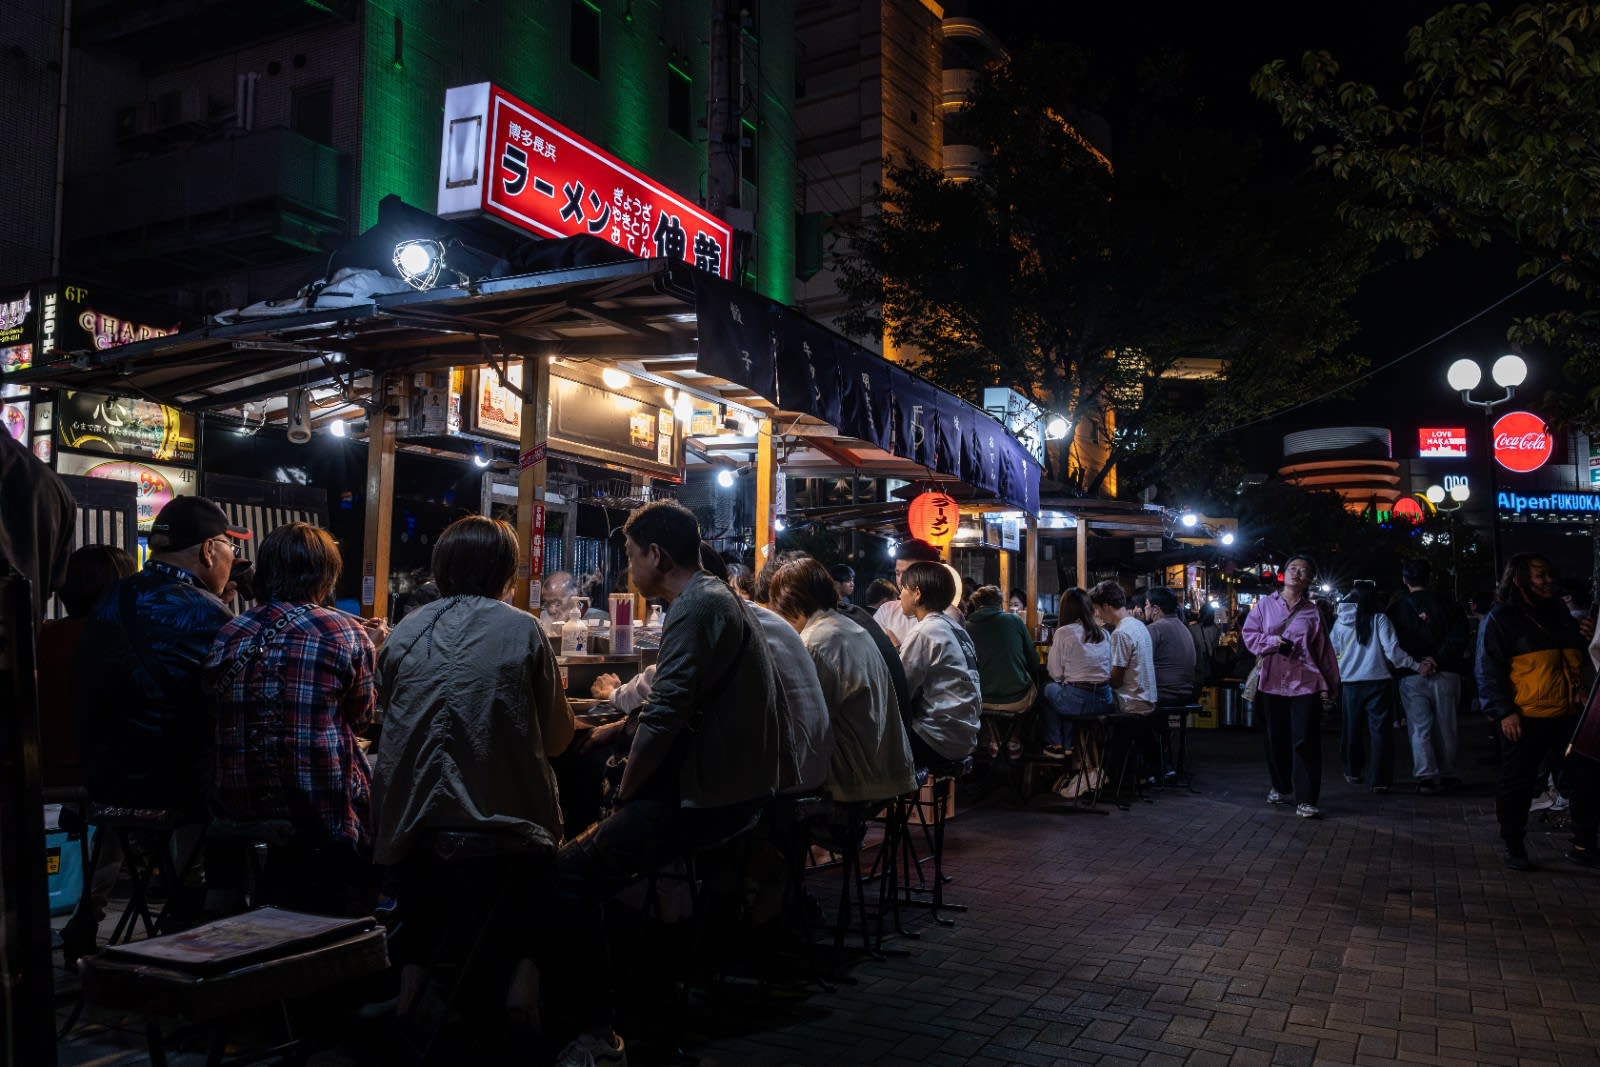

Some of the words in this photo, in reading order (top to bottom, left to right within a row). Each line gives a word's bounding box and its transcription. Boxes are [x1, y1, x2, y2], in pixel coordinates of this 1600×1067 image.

[508, 121, 557, 162] 博多長浜
[502, 142, 611, 233] ラーメン
[612, 207, 651, 239] やきとり
[611, 226, 651, 259] おでん
[65, 286, 88, 304] 6F
[1494, 432, 1546, 450] Coca-Cola
[178, 469, 195, 483] 4F
[931, 497, 950, 537] ラーメン
[1498, 492, 1549, 512] Alpen
[1551, 494, 1600, 511] FUKUOKA
